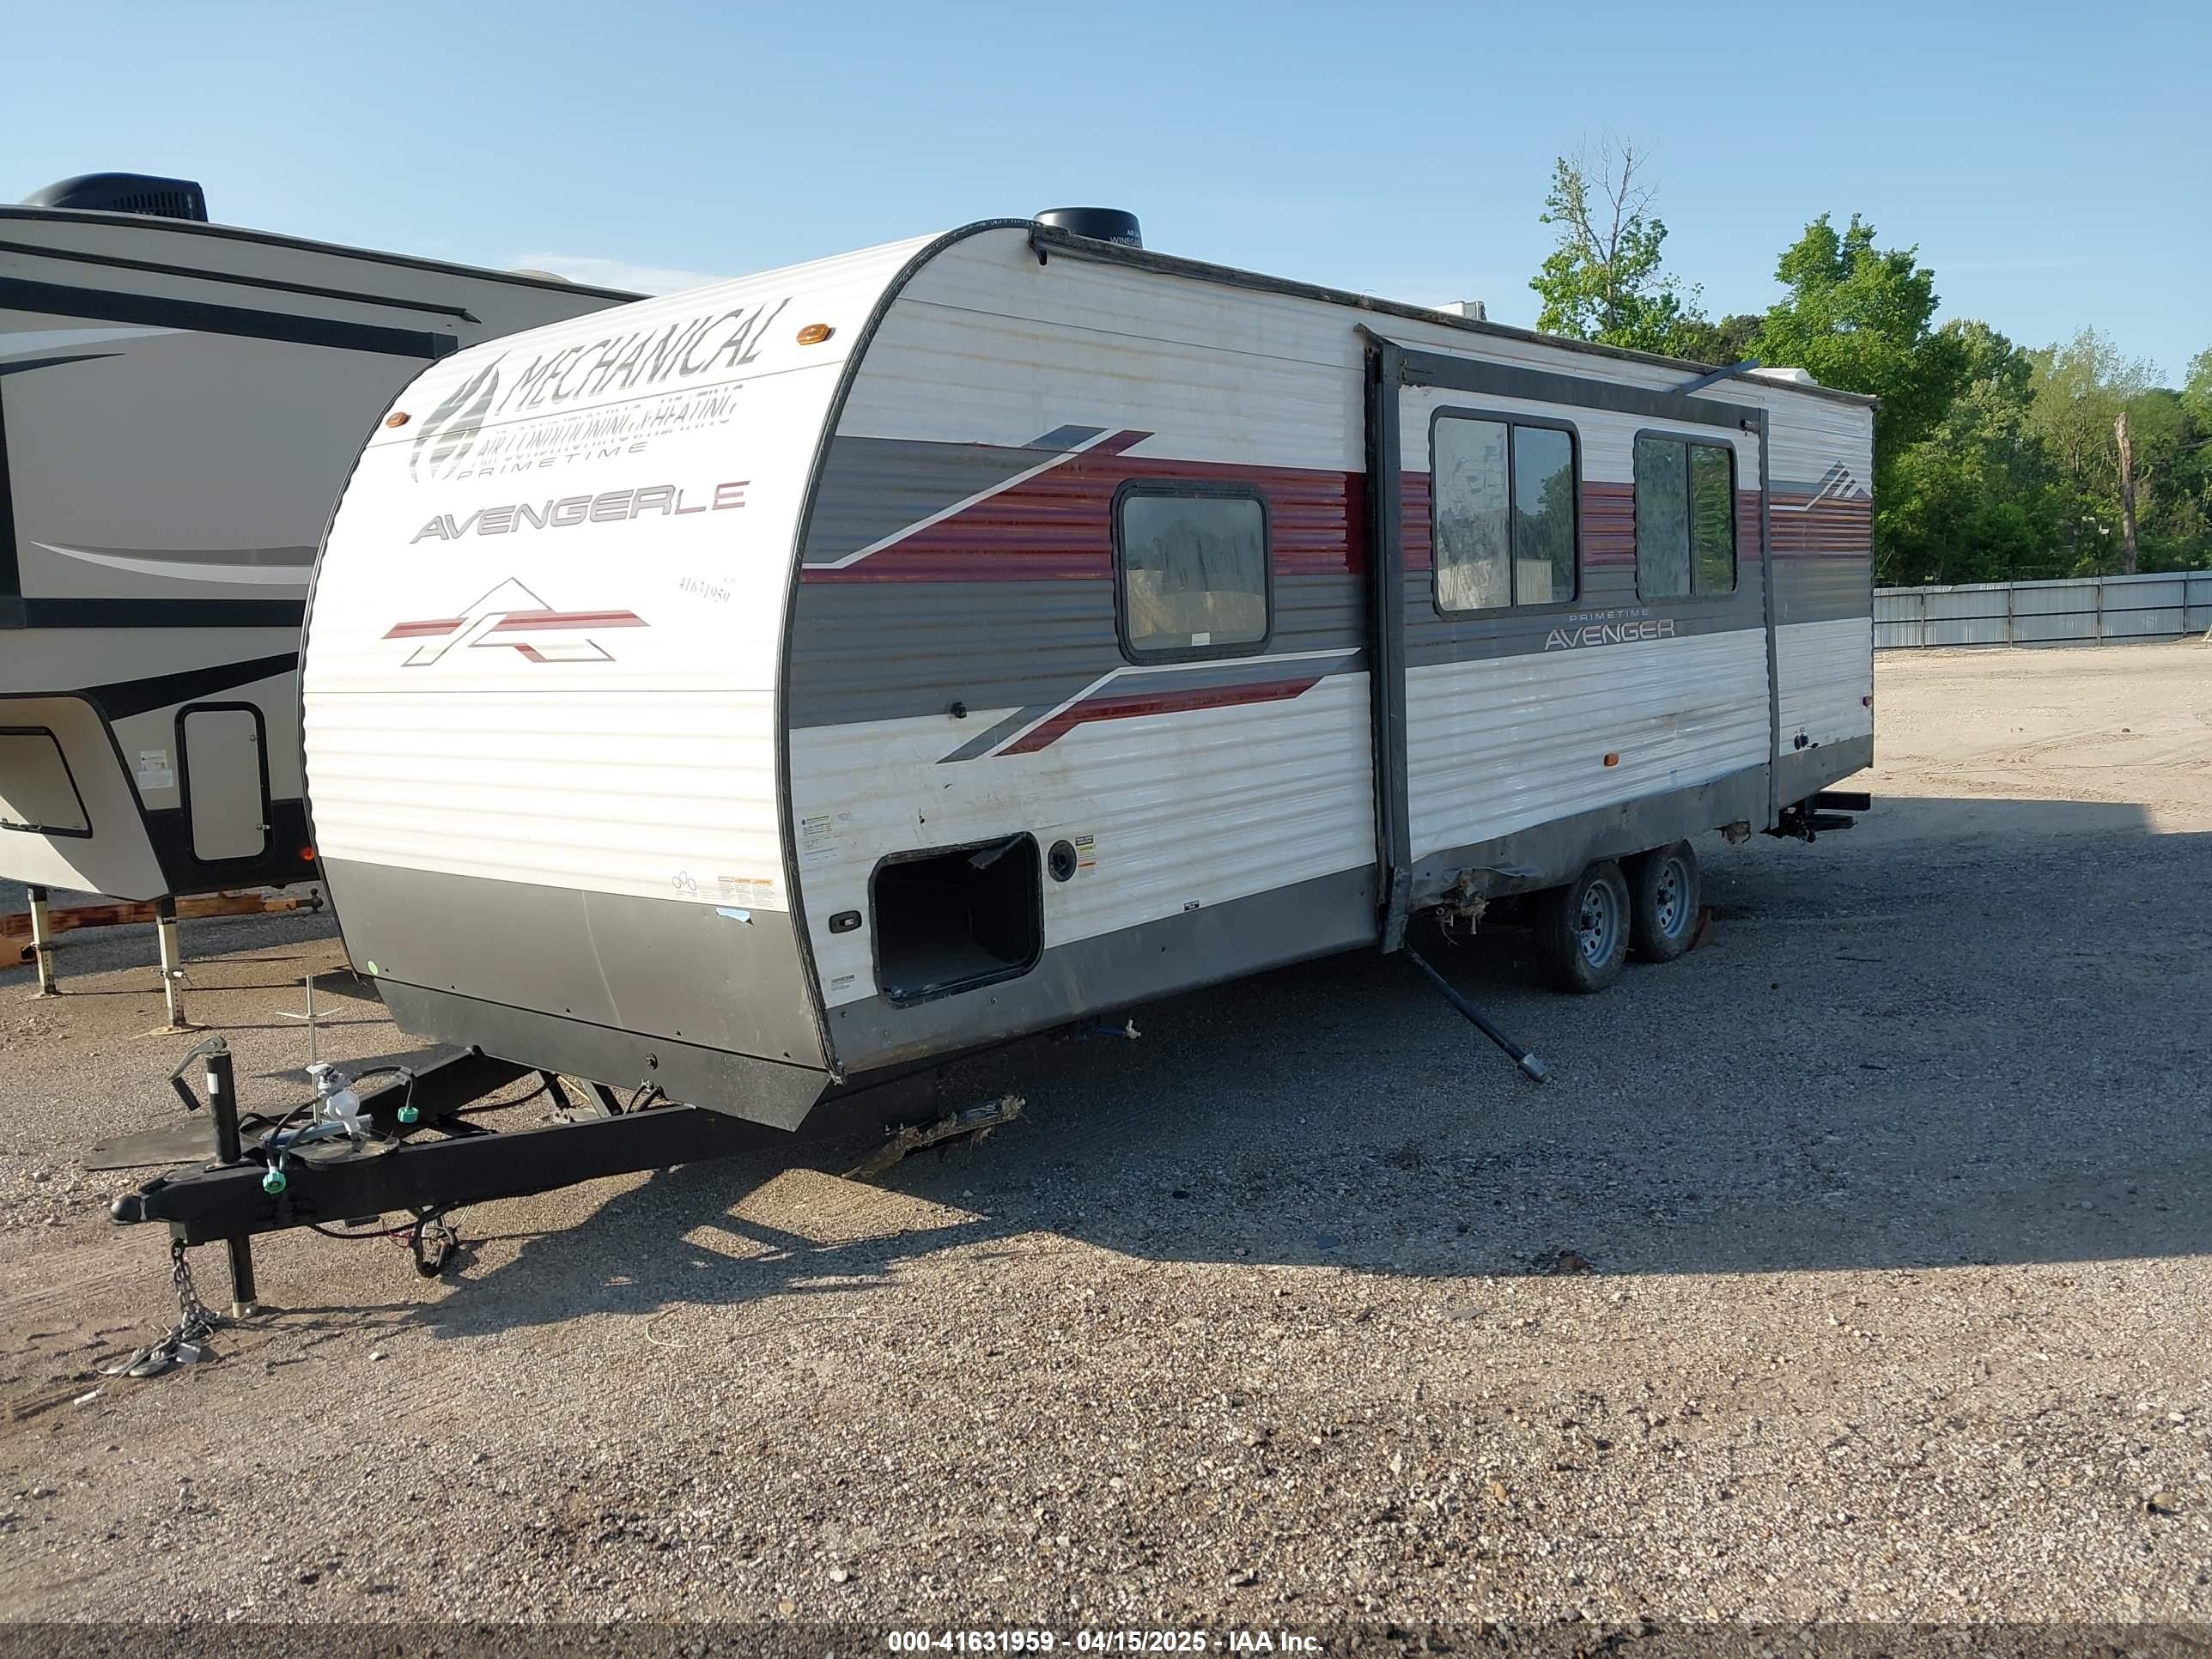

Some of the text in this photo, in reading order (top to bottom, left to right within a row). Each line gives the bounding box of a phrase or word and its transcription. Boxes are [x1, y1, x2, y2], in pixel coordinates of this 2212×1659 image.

[493, 296, 793, 416] MECHANICAL
[457, 441, 648, 481] PRIMETIME
[1569, 608, 1650, 623] PRIMETIME
[1544, 618, 1675, 651] AVENGER
